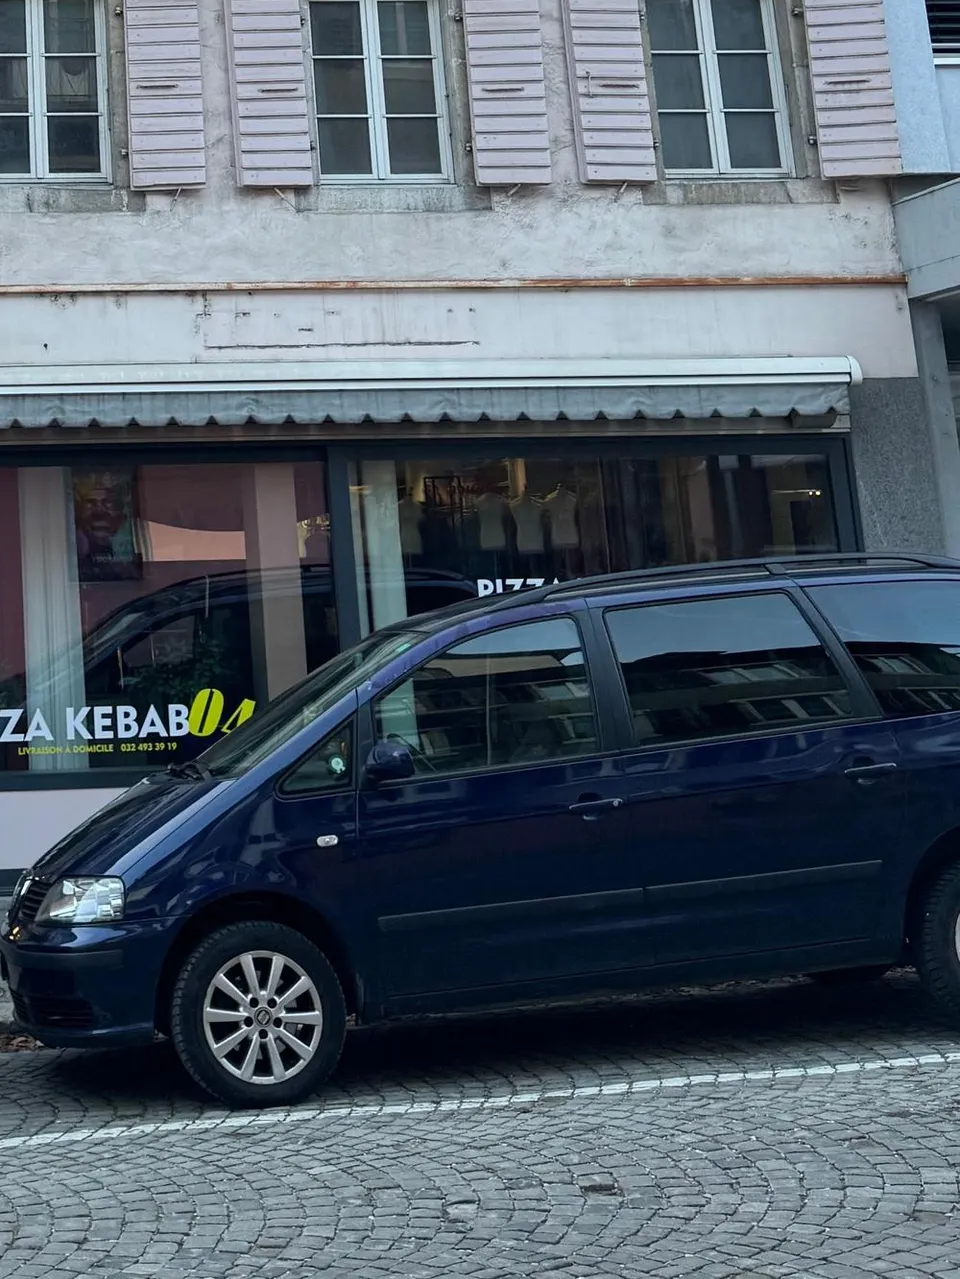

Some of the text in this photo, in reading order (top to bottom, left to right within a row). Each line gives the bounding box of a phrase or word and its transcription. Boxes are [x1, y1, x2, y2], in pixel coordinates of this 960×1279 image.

[18, 745, 62, 756] LIVRAISON
[74, 743, 114, 754] DOMICILE
[121, 742, 136, 752] 032
[137, 742, 153, 752] 493
[155, 742, 165, 751] 39
[167, 741, 178, 751] 19
